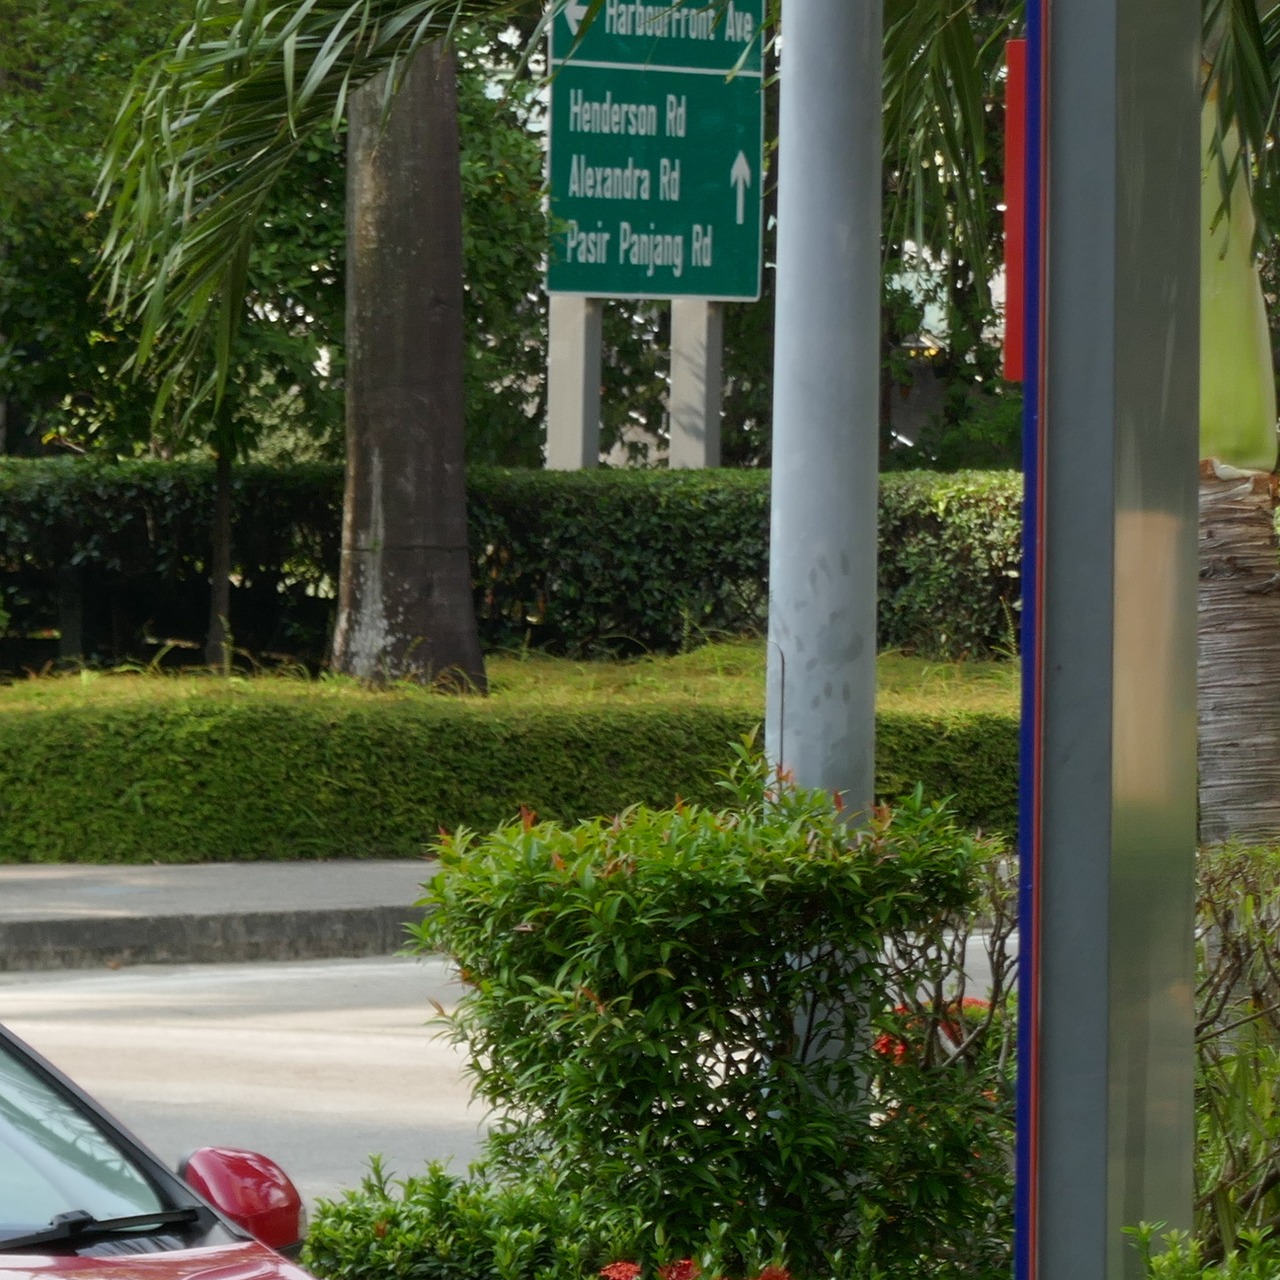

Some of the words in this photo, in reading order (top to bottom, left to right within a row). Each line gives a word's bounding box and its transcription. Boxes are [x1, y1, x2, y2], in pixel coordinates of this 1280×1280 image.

[724, 0, 753, 43] Ave
[569, 88, 657, 136] Henderson
[666, 94, 687, 137] Rd
[568, 154, 650, 200] Alexandra
[659, 158, 681, 201] Rd
[566, 219, 610, 264] Pasir
[619, 221, 684, 277] Panjang
[692, 224, 713, 267] Rd
